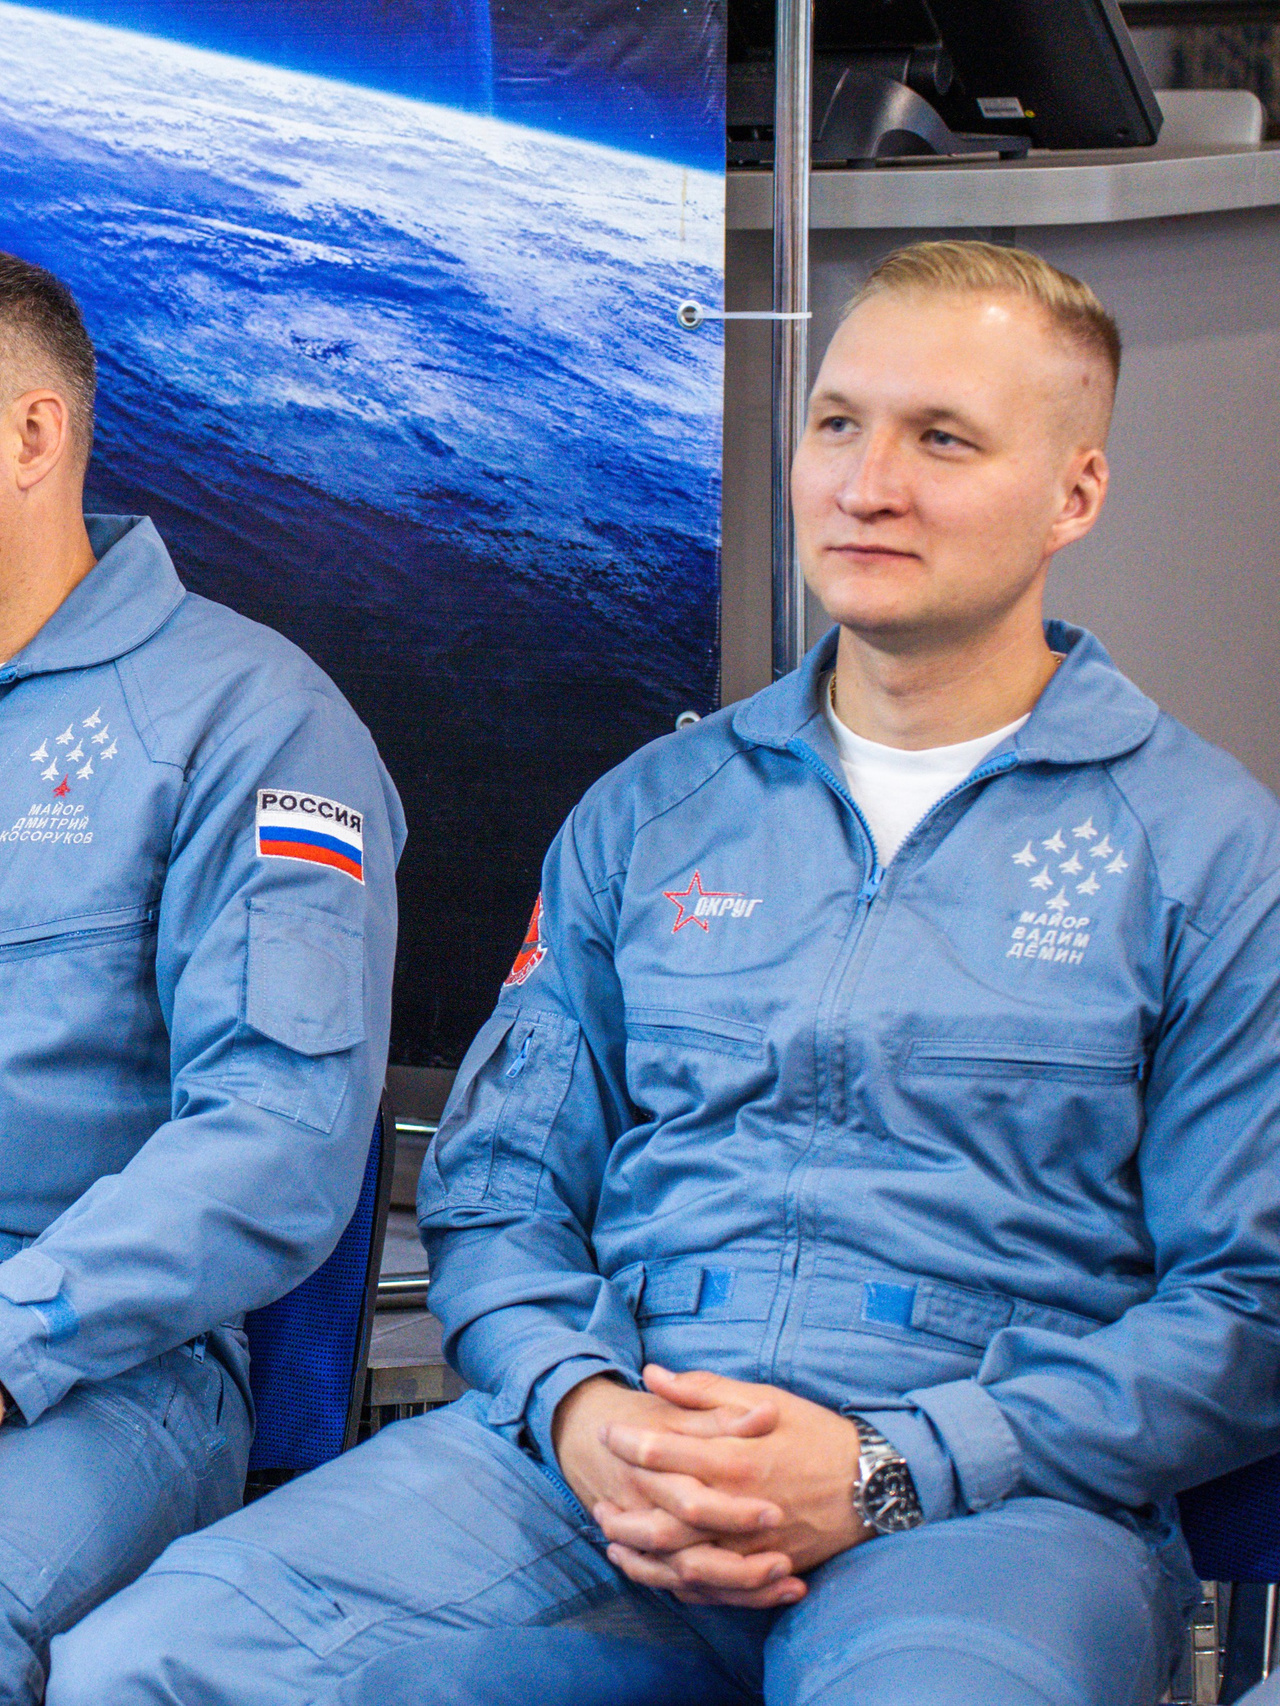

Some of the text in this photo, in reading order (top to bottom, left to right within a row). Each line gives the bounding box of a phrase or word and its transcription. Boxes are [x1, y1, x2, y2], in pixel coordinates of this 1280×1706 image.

[28, 801, 84, 816] МАЙОР
[262, 793, 360, 832] РОССИЯ
[12, 816, 89, 831] ДМИТРИЙ
[1019, 909, 1090, 929] МАЙОР
[1011, 926, 1090, 948] ВАДИМ
